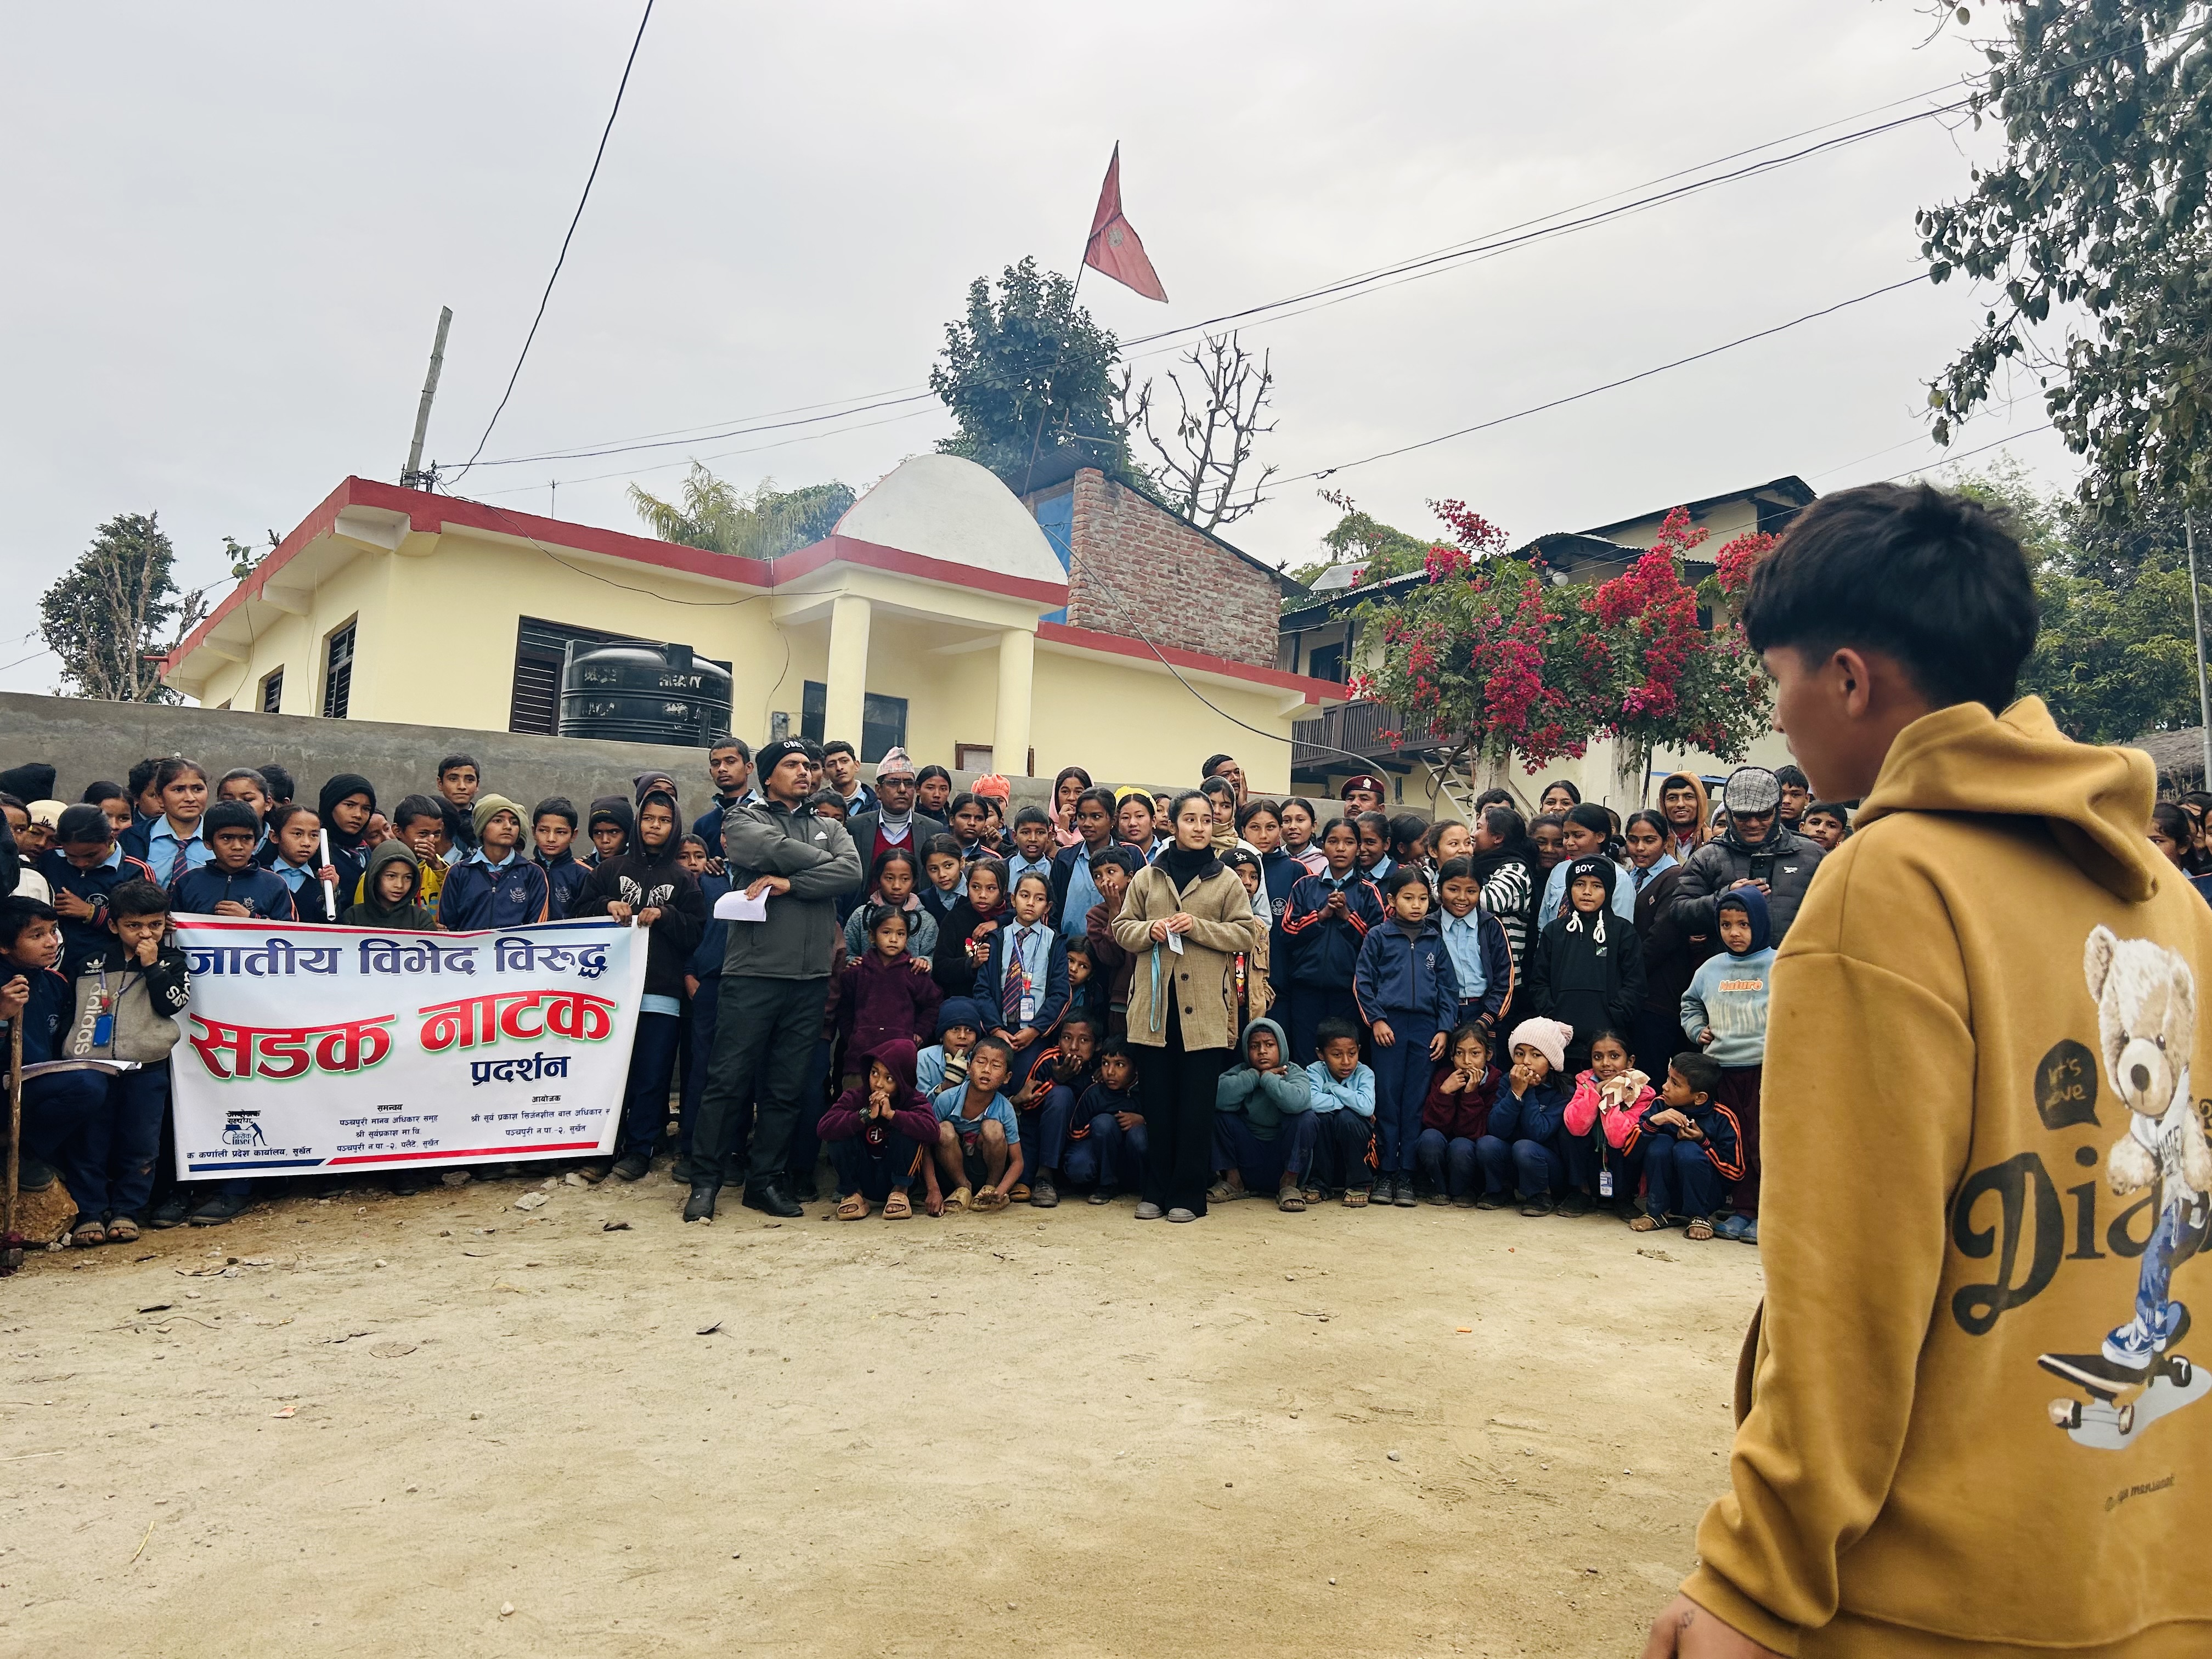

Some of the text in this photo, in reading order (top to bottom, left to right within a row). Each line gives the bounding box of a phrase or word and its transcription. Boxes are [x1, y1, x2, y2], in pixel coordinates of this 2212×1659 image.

[1575, 864, 1595, 874] BOY
[180, 938, 342, 976] जातीय
[358, 938, 479, 975] विभेद
[74, 983, 103, 1056] adidas
[189, 989, 616, 1080] सडक नाटक
[470, 1052, 571, 1086] प्रदर्शन
[377, 1104, 403, 1112] समन्वय
[471, 1114, 480, 1122] श्री
[575, 1108, 602, 1116] अधिकार
[393, 1115, 421, 1123] अधिकार
[199, 1149, 228, 1158] कर्णाली
[232, 1149, 251, 1158] प्रदेश
[292, 1146, 312, 1156] सुर्खेत
